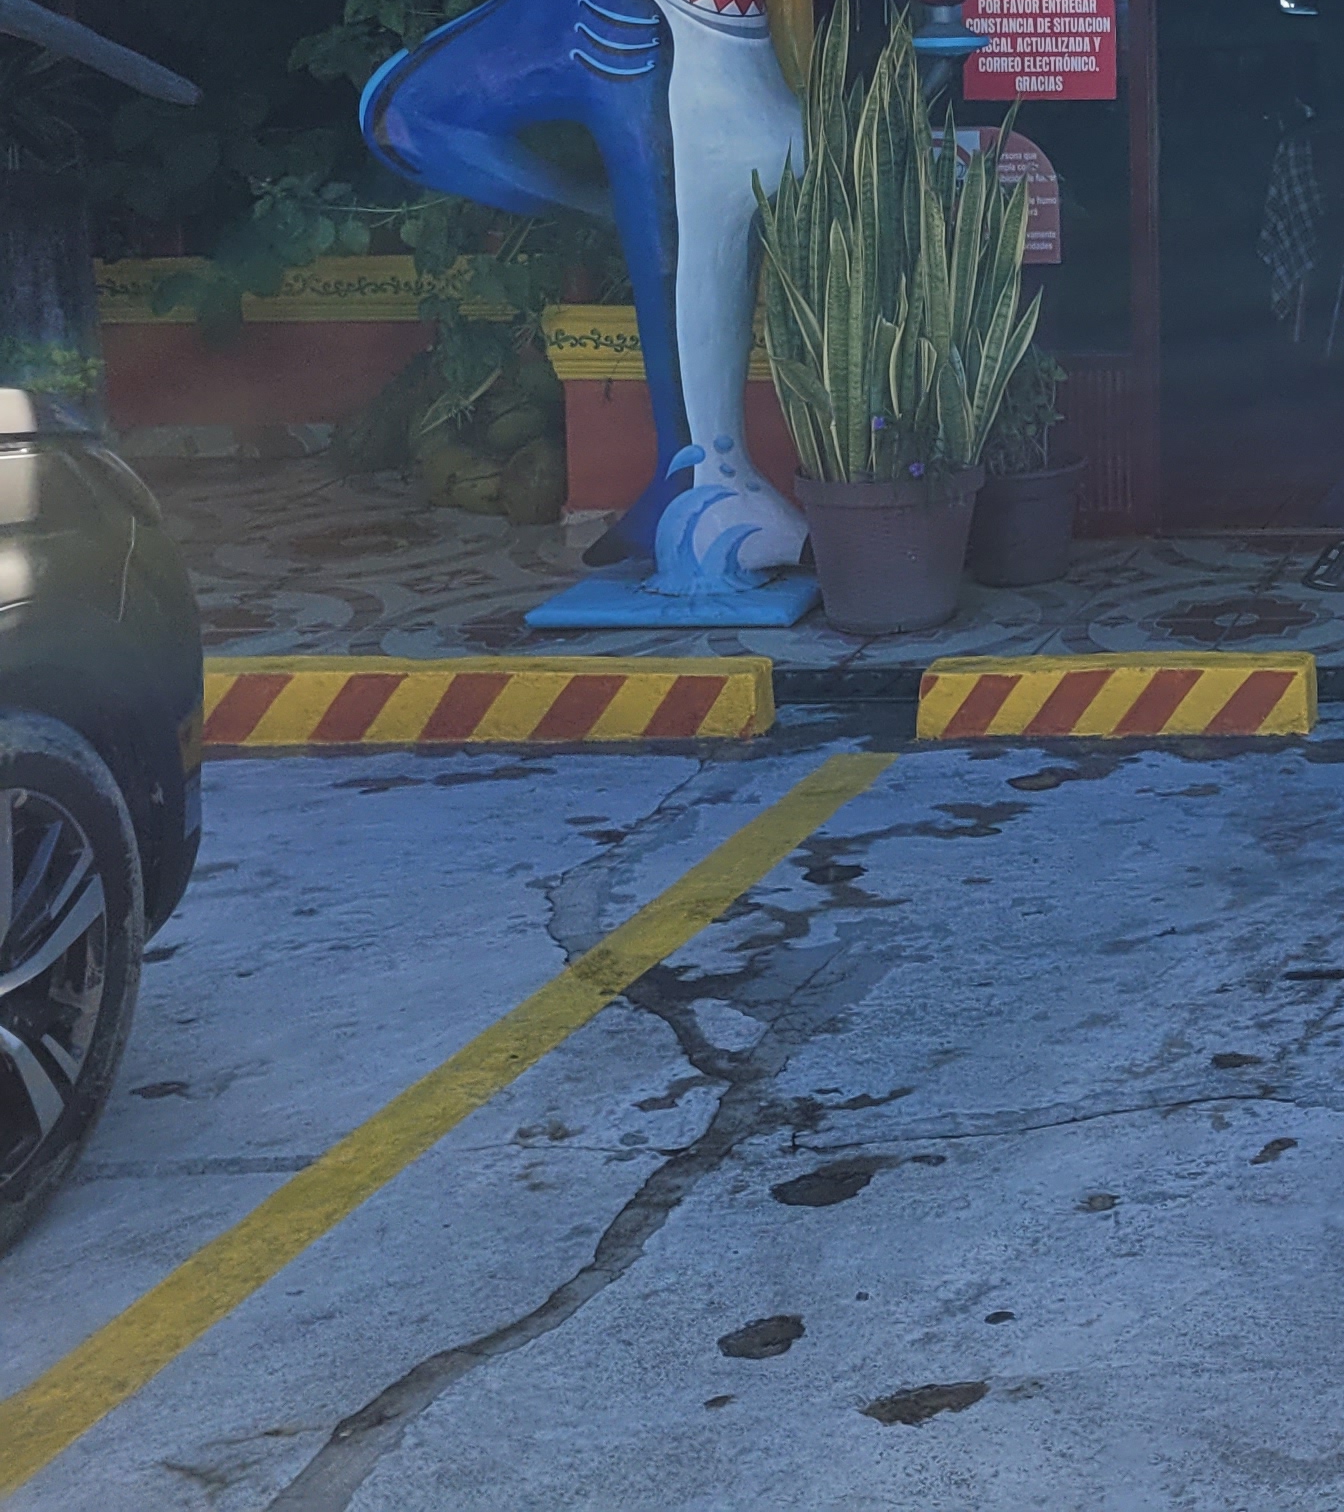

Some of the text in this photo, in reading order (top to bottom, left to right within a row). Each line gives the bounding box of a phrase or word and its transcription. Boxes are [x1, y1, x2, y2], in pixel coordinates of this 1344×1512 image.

[965, 16, 1111, 34] CONSTANCIA DE SITUACION
[976, 36, 1102, 53] SCAL ACTUALIZADA Y
[978, 54, 1100, 73] CORREO ELECTRÓNICO.
[1015, 75, 1064, 92] GRACIAS
